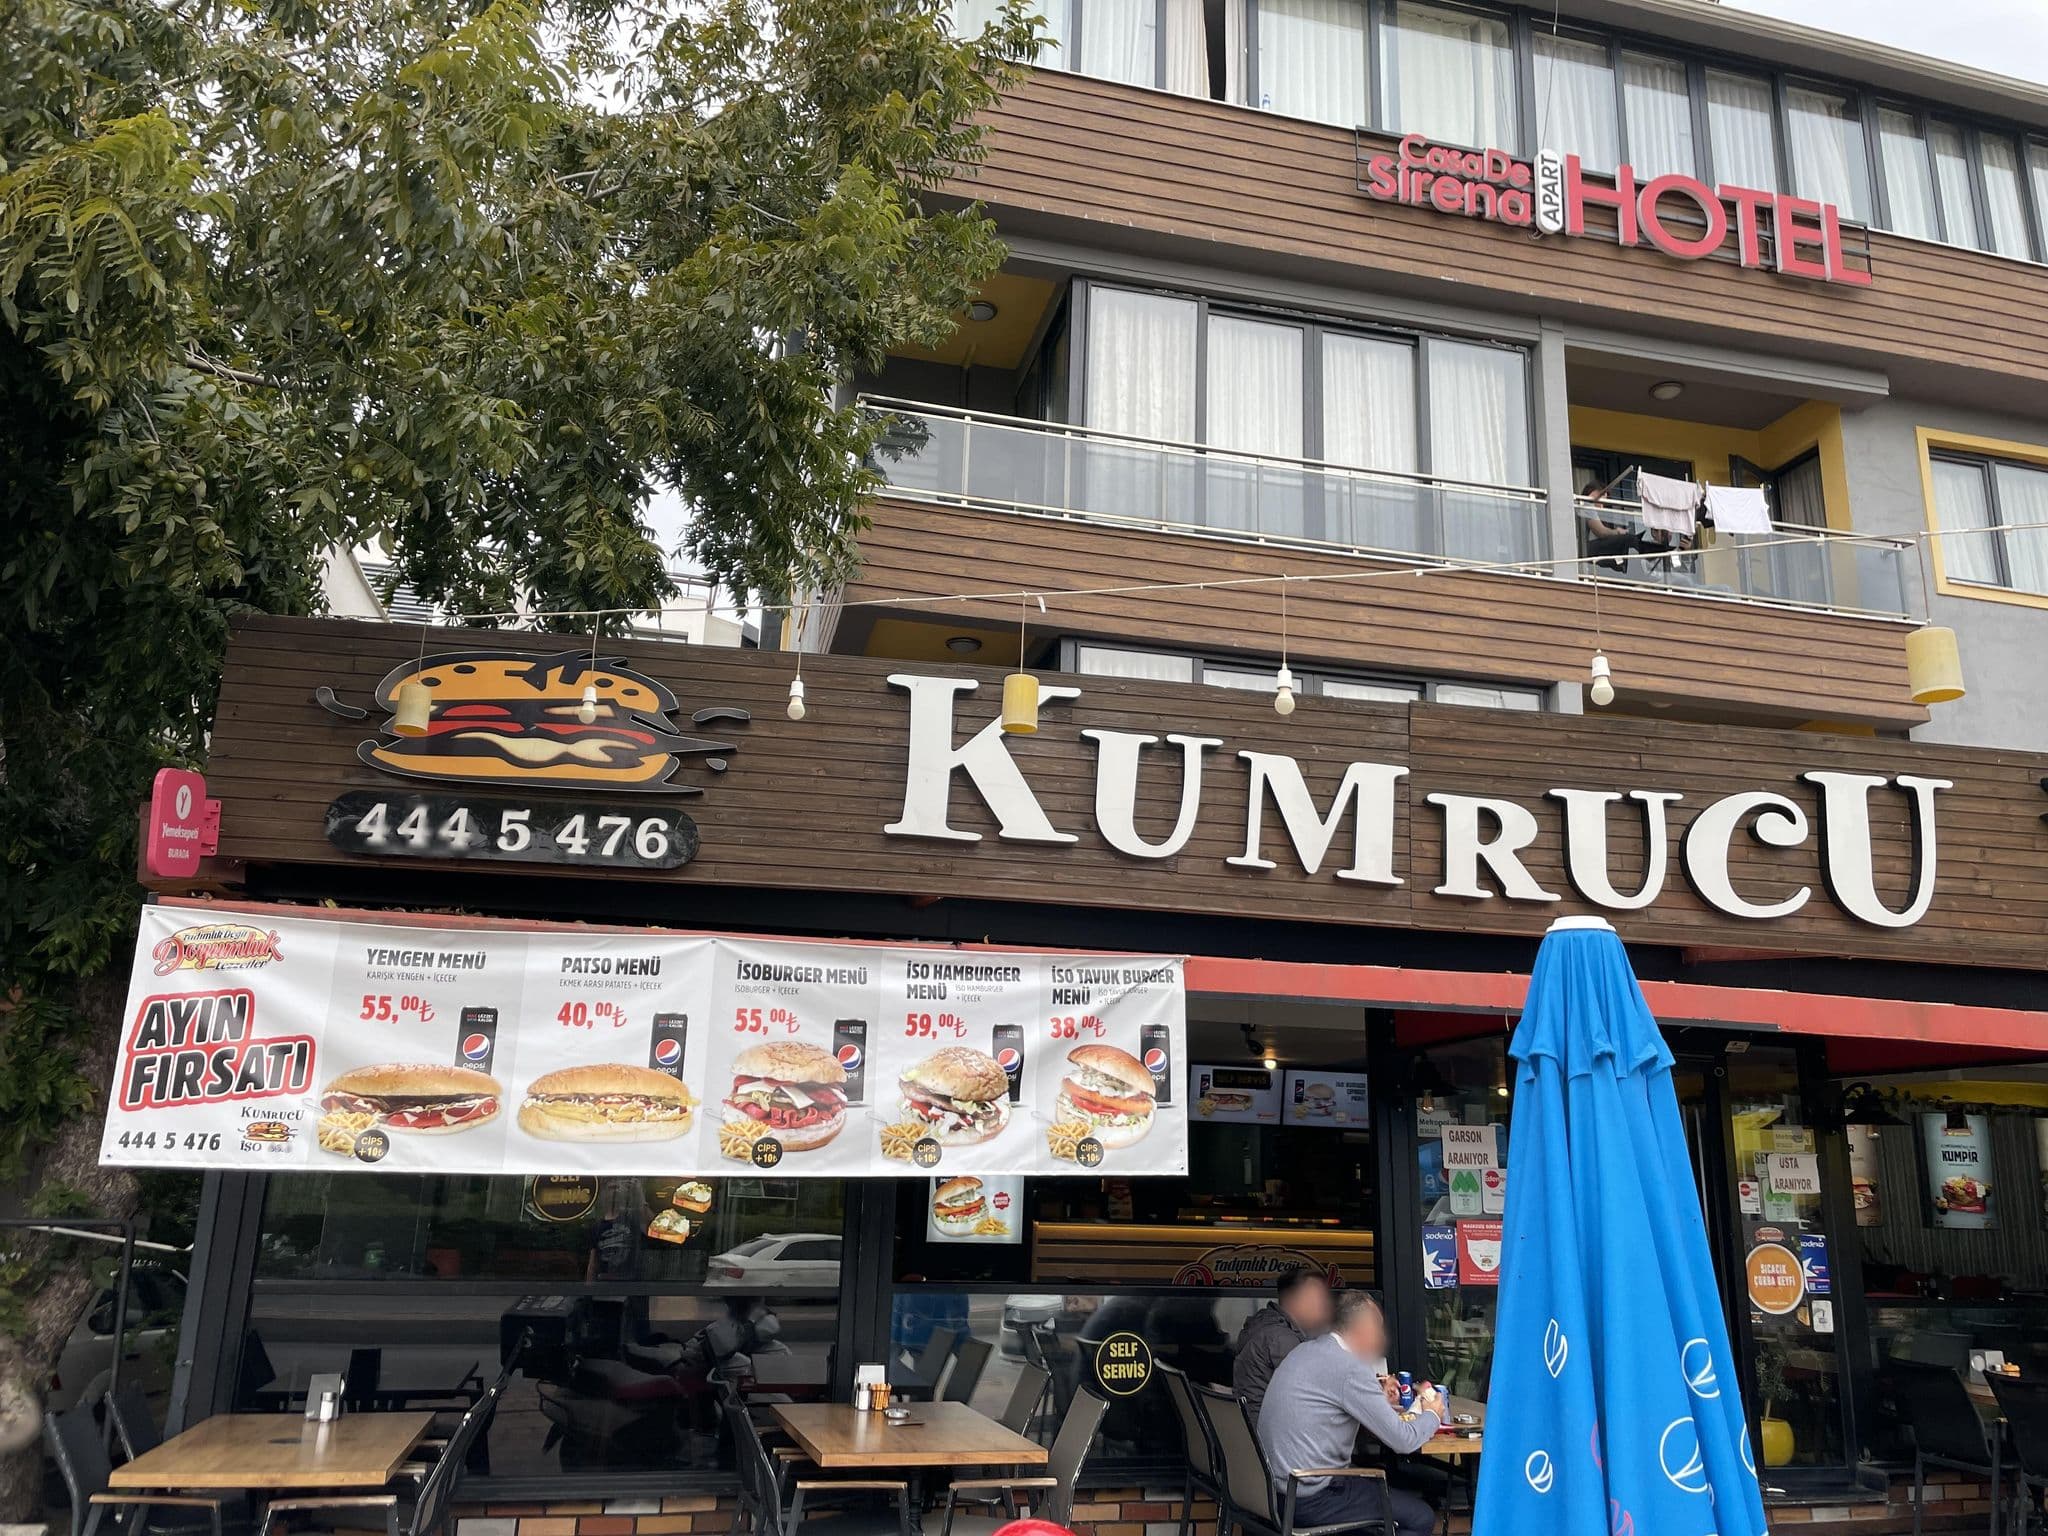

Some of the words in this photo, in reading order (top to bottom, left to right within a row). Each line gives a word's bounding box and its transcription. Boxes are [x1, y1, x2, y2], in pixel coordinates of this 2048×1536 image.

[1367, 155, 1531, 225] Sirena
[1541, 154, 1560, 225] APART
[1564, 154, 1873, 286] HOTEL
[356, 803, 473, 848] 444
[497, 809, 531, 851] 5
[555, 814, 669, 859] 476
[367, 948, 434, 967] YENGEN
[437, 951, 487, 970] MENÜ
[561, 957, 612, 974] PATSO
[615, 955, 661, 976] MENÜ
[396, 973, 425, 982] YENGEN
[737, 960, 823, 983] İSOBURGER
[826, 967, 868, 985] MENÜ
[906, 960, 930, 981] İSO
[933, 964, 1021, 982] HAMBURGER
[1051, 966, 1074, 983] İSO
[1077, 969, 1120, 985] TAVUK
[1123, 969, 1174, 985] BURGER
[560, 979, 582, 988] EKMEK
[906, 982, 947, 1001] MENÜ
[1052, 987, 1091, 1005] MENÜ
[136, 995, 247, 1049] AYIN
[128, 1043, 308, 1104] FIRSATI
[241, 1106, 305, 1120] KUMRUCU
[118, 1131, 156, 1149] 444
[163, 1132, 176, 1149] 5
[183, 1132, 221, 1150] 476
[240, 1140, 262, 1152] İSO
[1449, 1130, 1482, 1143] GARSON
[1448, 1152, 1489, 1165] ARANIYOR
[1779, 1157, 1800, 1169] USTA
[1941, 1149, 1978, 1163] KUMPİR
[1775, 1179, 1812, 1190] ARANIYOR
[1425, 1229, 1453, 1240] sodexo
[1214, 1257, 1266, 1272] Tadımlık
[1110, 1342, 1138, 1357] SELF
[1103, 1360, 1146, 1379] SERVİS
